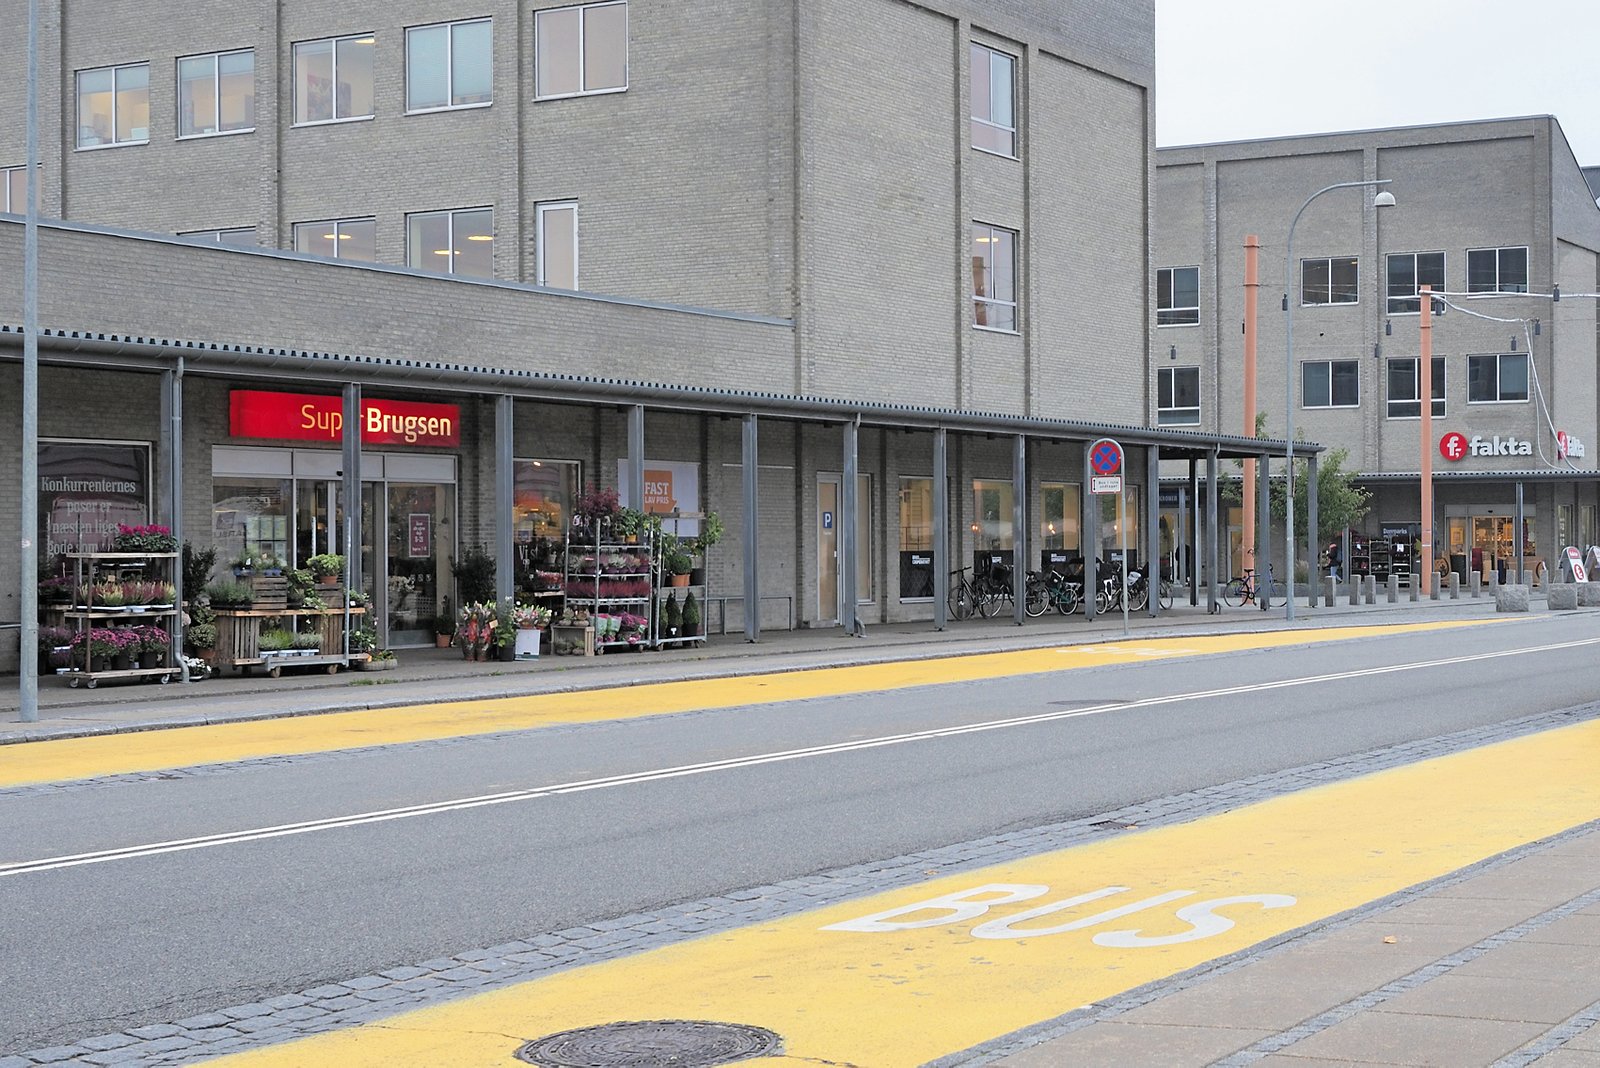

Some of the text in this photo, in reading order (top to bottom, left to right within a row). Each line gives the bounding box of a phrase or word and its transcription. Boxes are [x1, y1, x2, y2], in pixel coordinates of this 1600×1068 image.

[301, 404, 451, 442] SupBrugsen
[1469, 435, 1532, 456] fakta
[41, 476, 136, 493] Konkurrenternes
[645, 482, 669, 495] FAST
[645, 496, 655, 504] LAV
[67, 501, 112, 516] poser er
[52, 520, 91, 534] næsten
[825, 513, 831, 528] P
[47, 540, 73, 558] gode
[817, 883, 1297, 947] BUS
